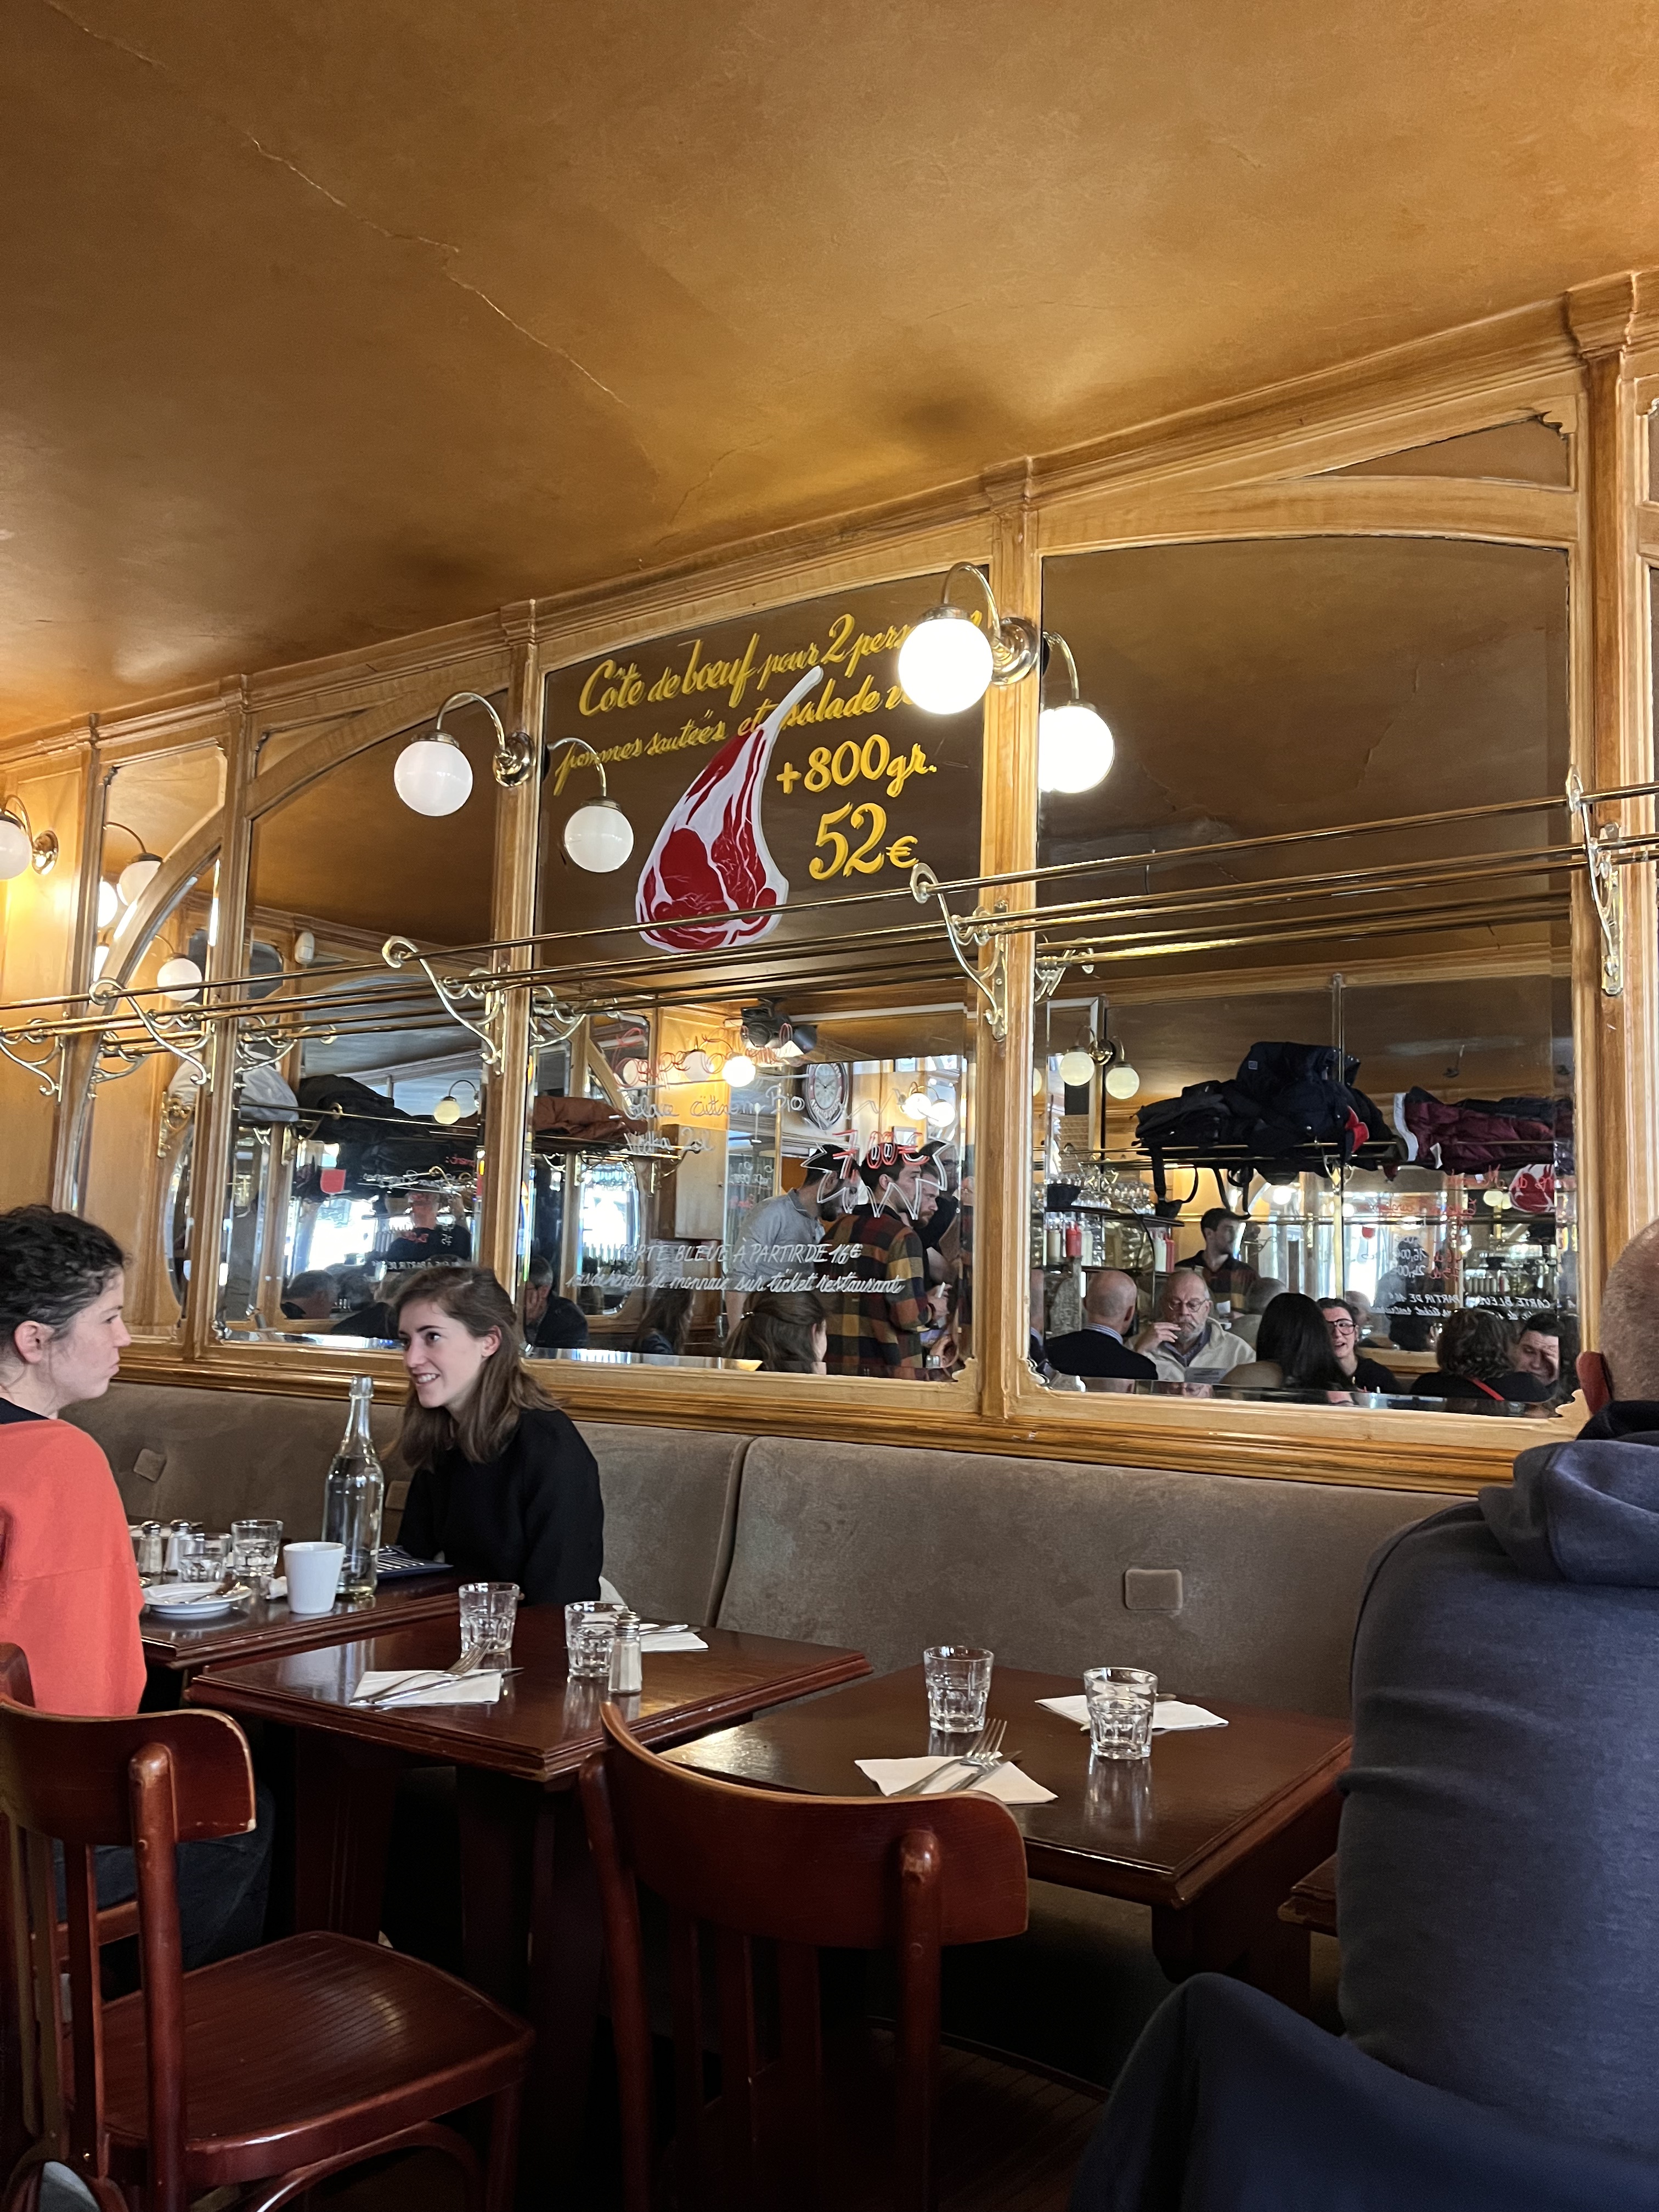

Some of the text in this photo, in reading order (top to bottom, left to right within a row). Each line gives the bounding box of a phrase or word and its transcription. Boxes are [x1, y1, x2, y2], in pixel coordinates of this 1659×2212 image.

[579, 659, 646, 716] Côte
[647, 666, 681, 702] de
[757, 642, 820, 691] pour
[820, 613, 855, 665] 2
[554, 737, 644, 797] pommes
[737, 698, 780, 736] et
[780, 674, 883, 730] salade
[809, 801, 919, 881] 52€
[765, 1084, 805, 1115] Bio
[675, 1243, 732, 1262] BLEUE
[748, 1243, 804, 1263] PARTIR
[804, 1243, 832, 1263] DE
[734, 1275, 765, 1292] sur
[766, 1268, 819, 1293] ticket
[815, 1271, 906, 1294] restaurant
